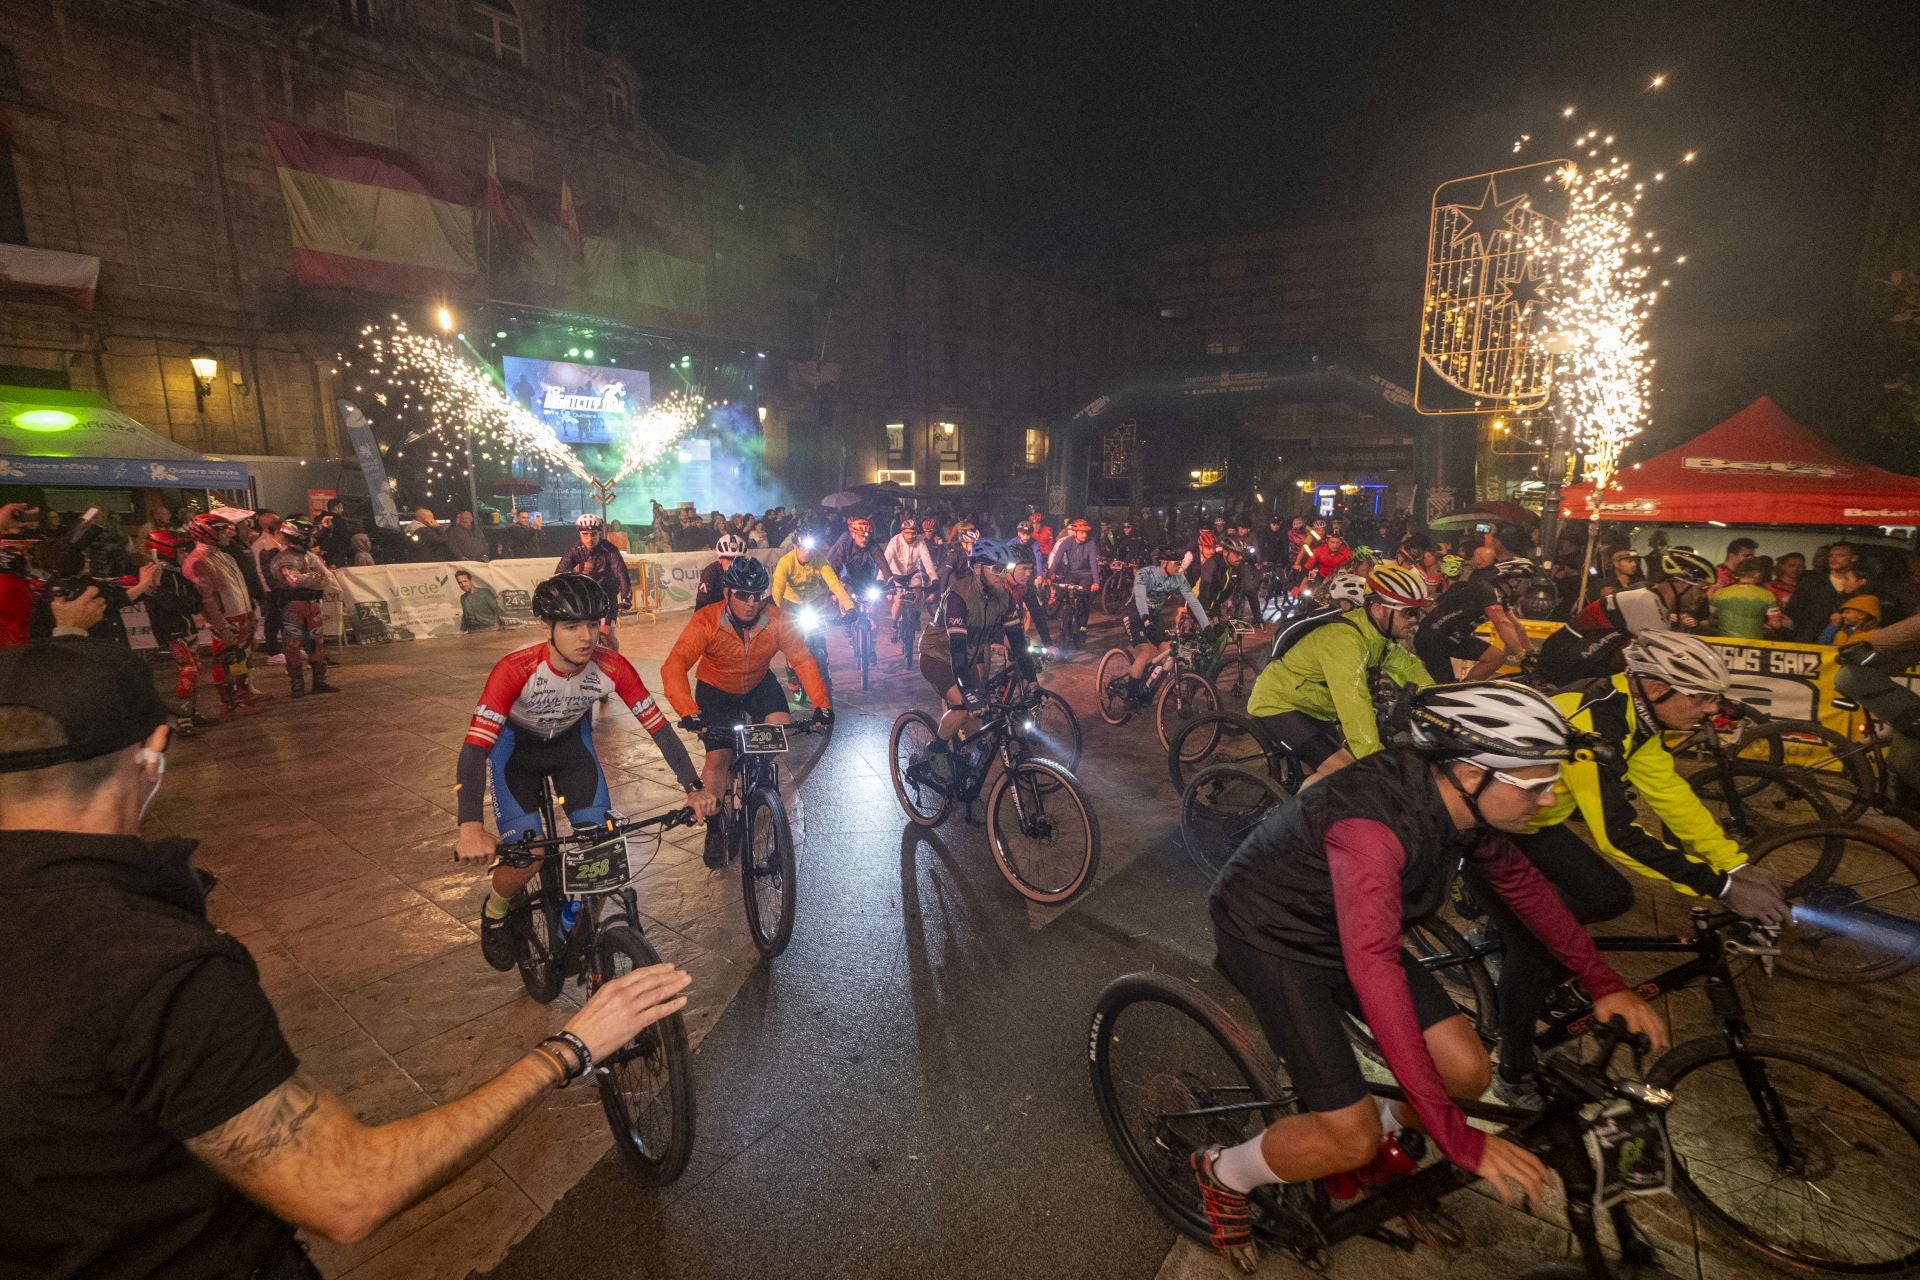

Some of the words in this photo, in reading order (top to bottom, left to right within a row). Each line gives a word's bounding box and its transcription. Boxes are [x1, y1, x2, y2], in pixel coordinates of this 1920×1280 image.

[1685, 457, 1836, 477] Beta
[1723, 646, 1761, 672] SUS
[1769, 651, 1820, 677] SAIZ
[751, 731, 773, 742] 230
[575, 858, 610, 880] 258
[1089, 1012, 1104, 1062] MAXXIS
